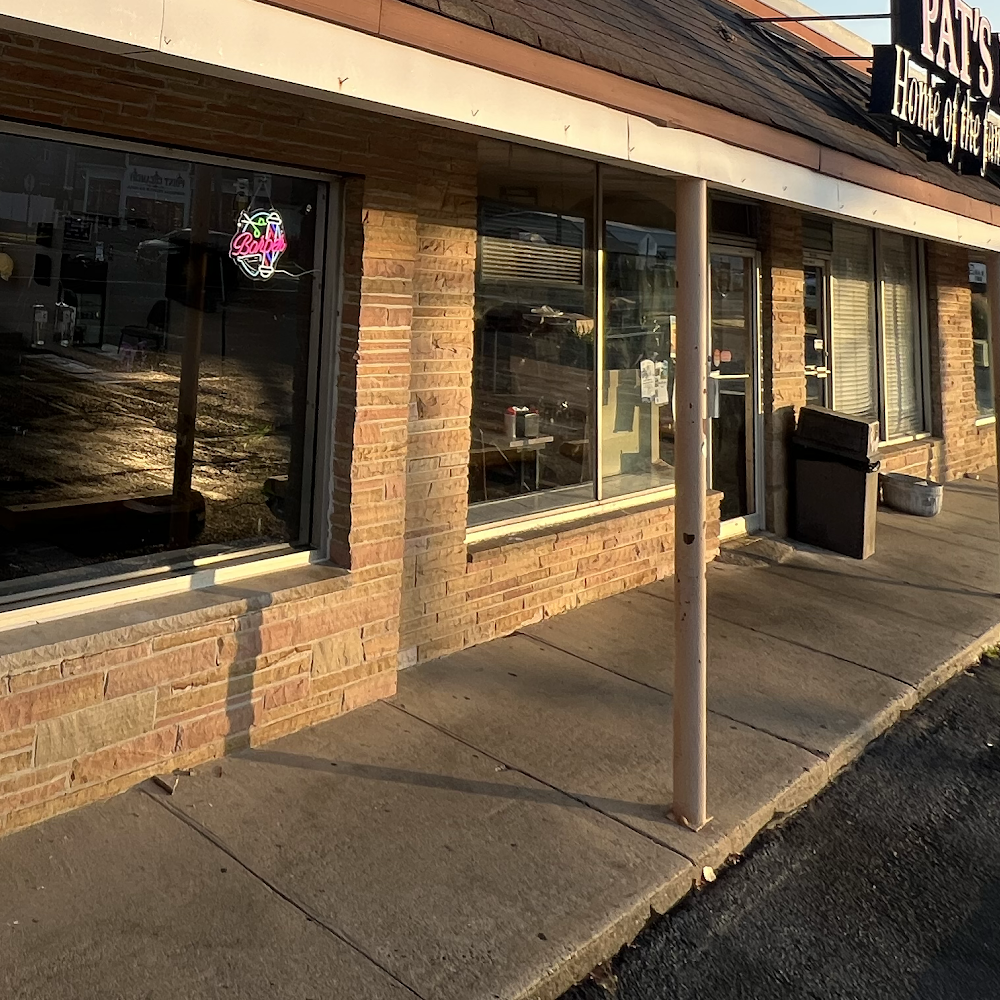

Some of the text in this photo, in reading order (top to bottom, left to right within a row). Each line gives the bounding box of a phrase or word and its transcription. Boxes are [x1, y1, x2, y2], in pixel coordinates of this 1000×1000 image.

[891, 44, 941, 137] Home
[943, 82, 961, 164] of
[960, 89, 981, 157] the
